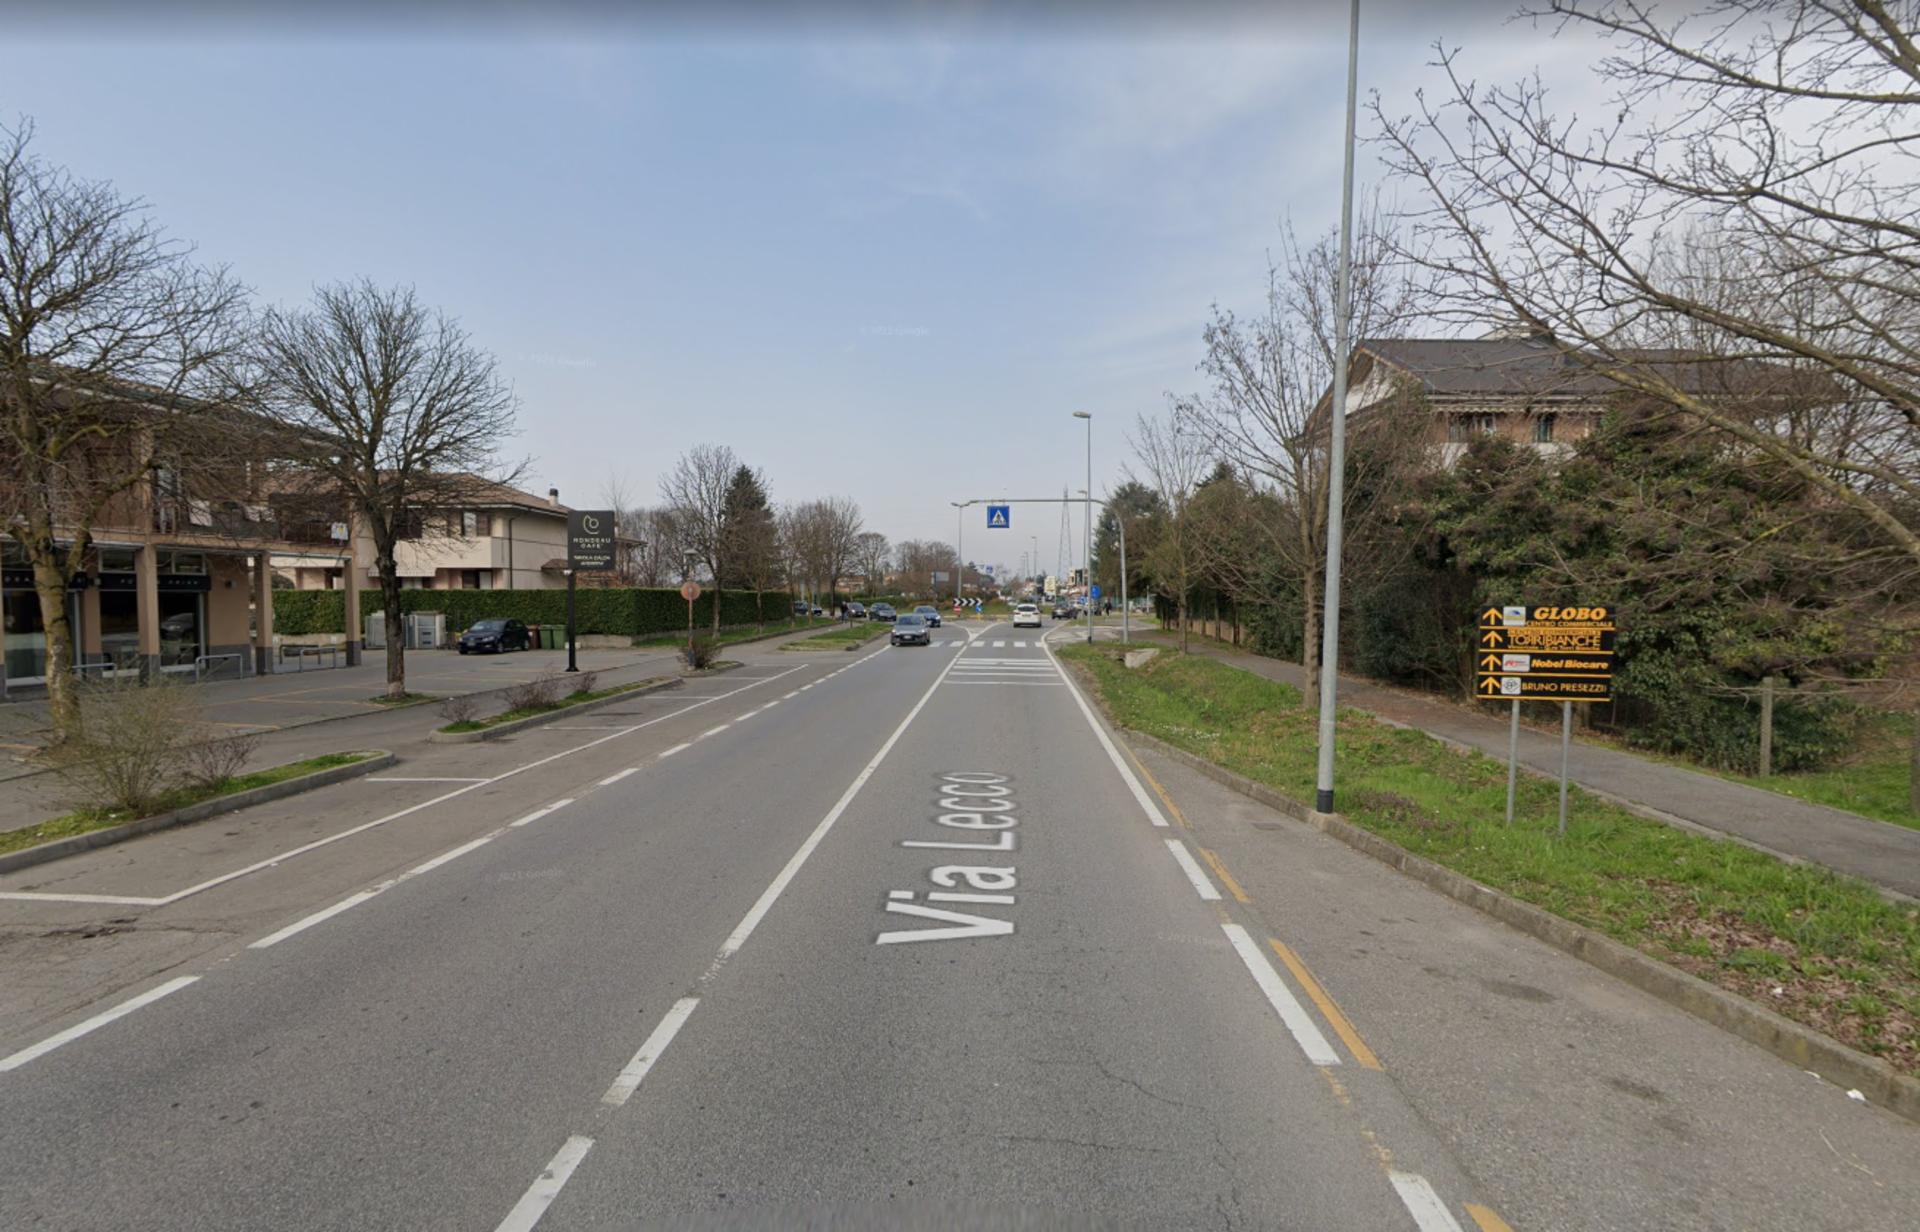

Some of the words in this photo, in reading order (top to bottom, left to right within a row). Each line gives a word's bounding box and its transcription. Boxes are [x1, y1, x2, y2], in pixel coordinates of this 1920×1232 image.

[1534, 606, 1607, 620] GLOBO
[1531, 659, 1563, 668] Nobel
[1564, 659, 1609, 669] Biocare
[1522, 682, 1558, 691] BRUNO
[902, 772, 1018, 850] Lecco
[876, 865, 1016, 945] Via
